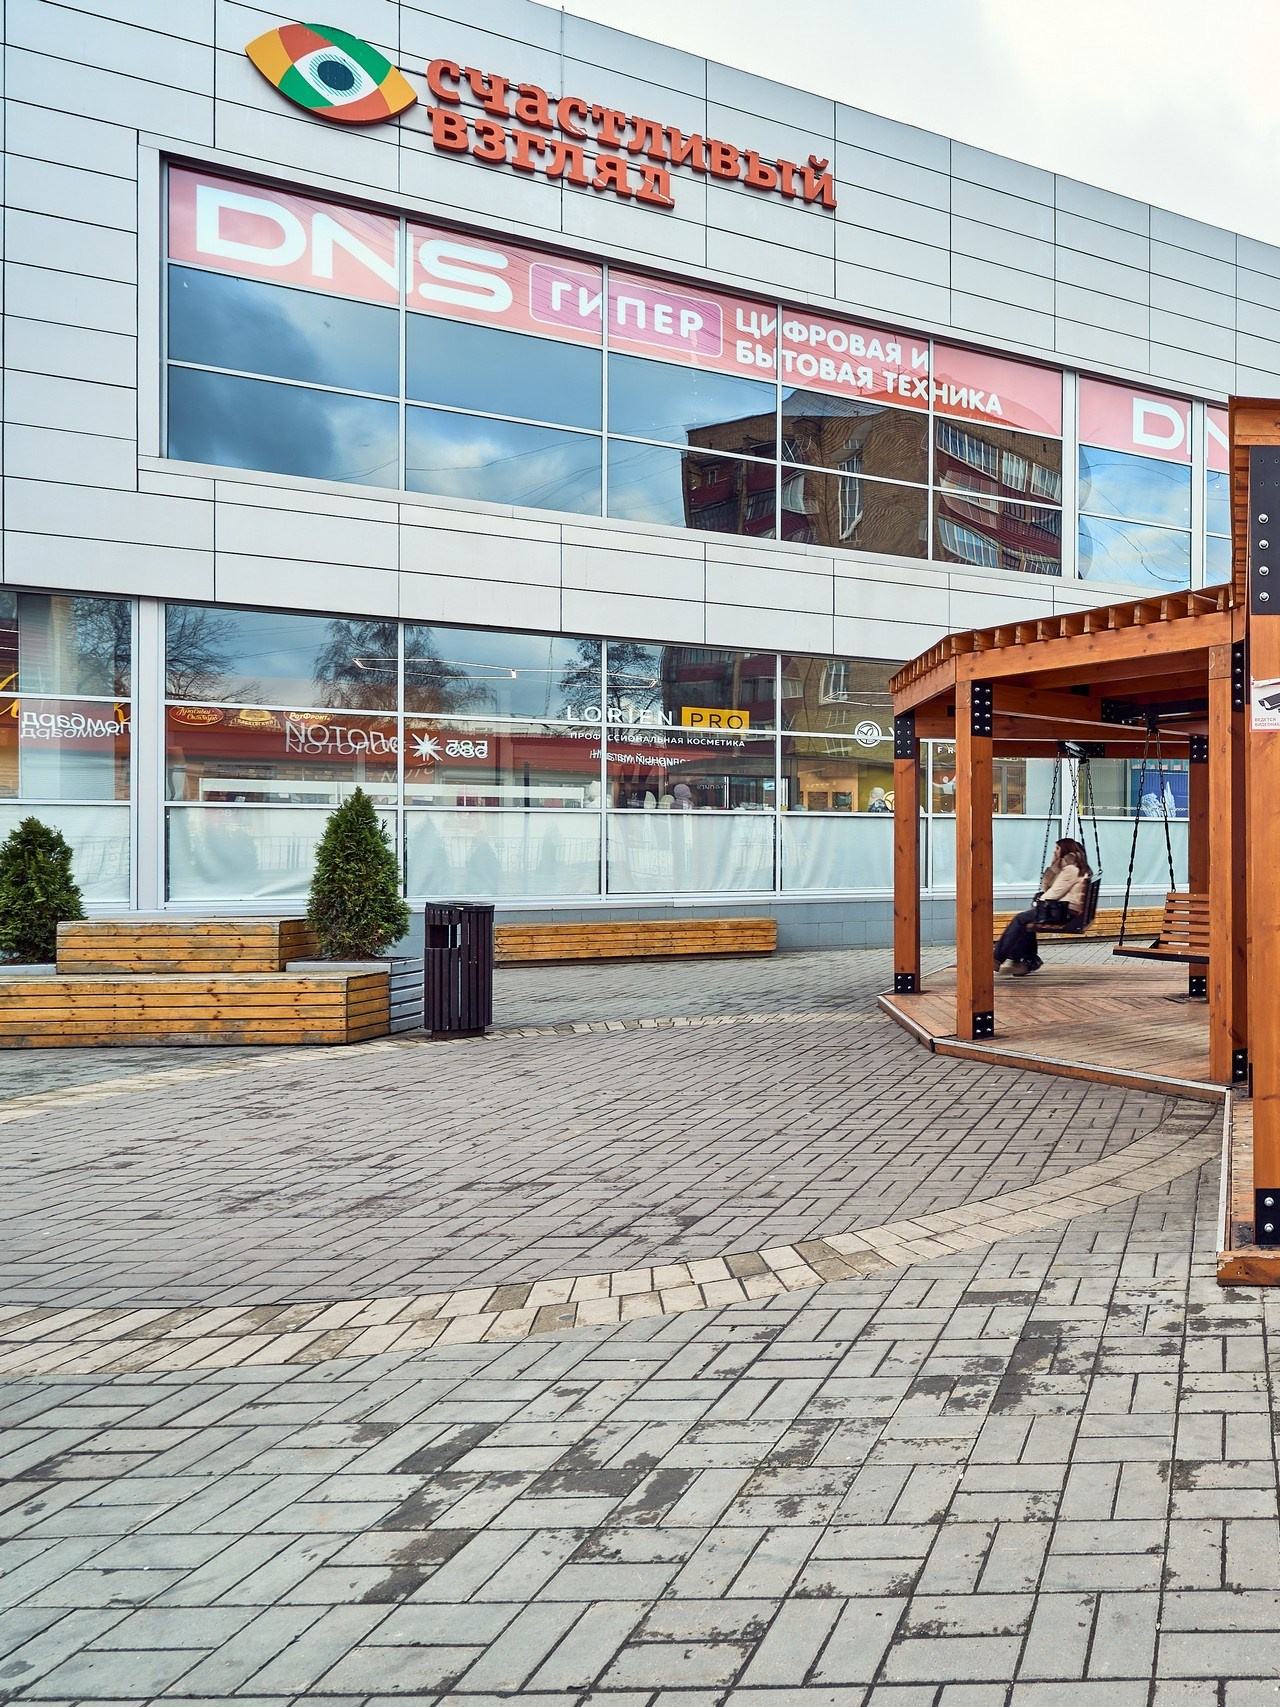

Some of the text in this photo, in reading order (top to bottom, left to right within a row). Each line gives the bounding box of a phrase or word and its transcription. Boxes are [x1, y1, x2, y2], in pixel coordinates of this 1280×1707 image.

[196, 184, 513, 313] DNS
[551, 281, 704, 339] ГИПЕР
[735, 308, 930, 372] ЦИФРОВАЯ И
[736, 340, 1004, 416] БЫТОВАЯ ТЕХНИКА
[1132, 397, 1229, 460] DN
[567, 706, 743, 729] LORIEN PRO
[570, 732, 745, 747] ПРОФССИОНАЛЬНАЯ КОСМЕТИКА
